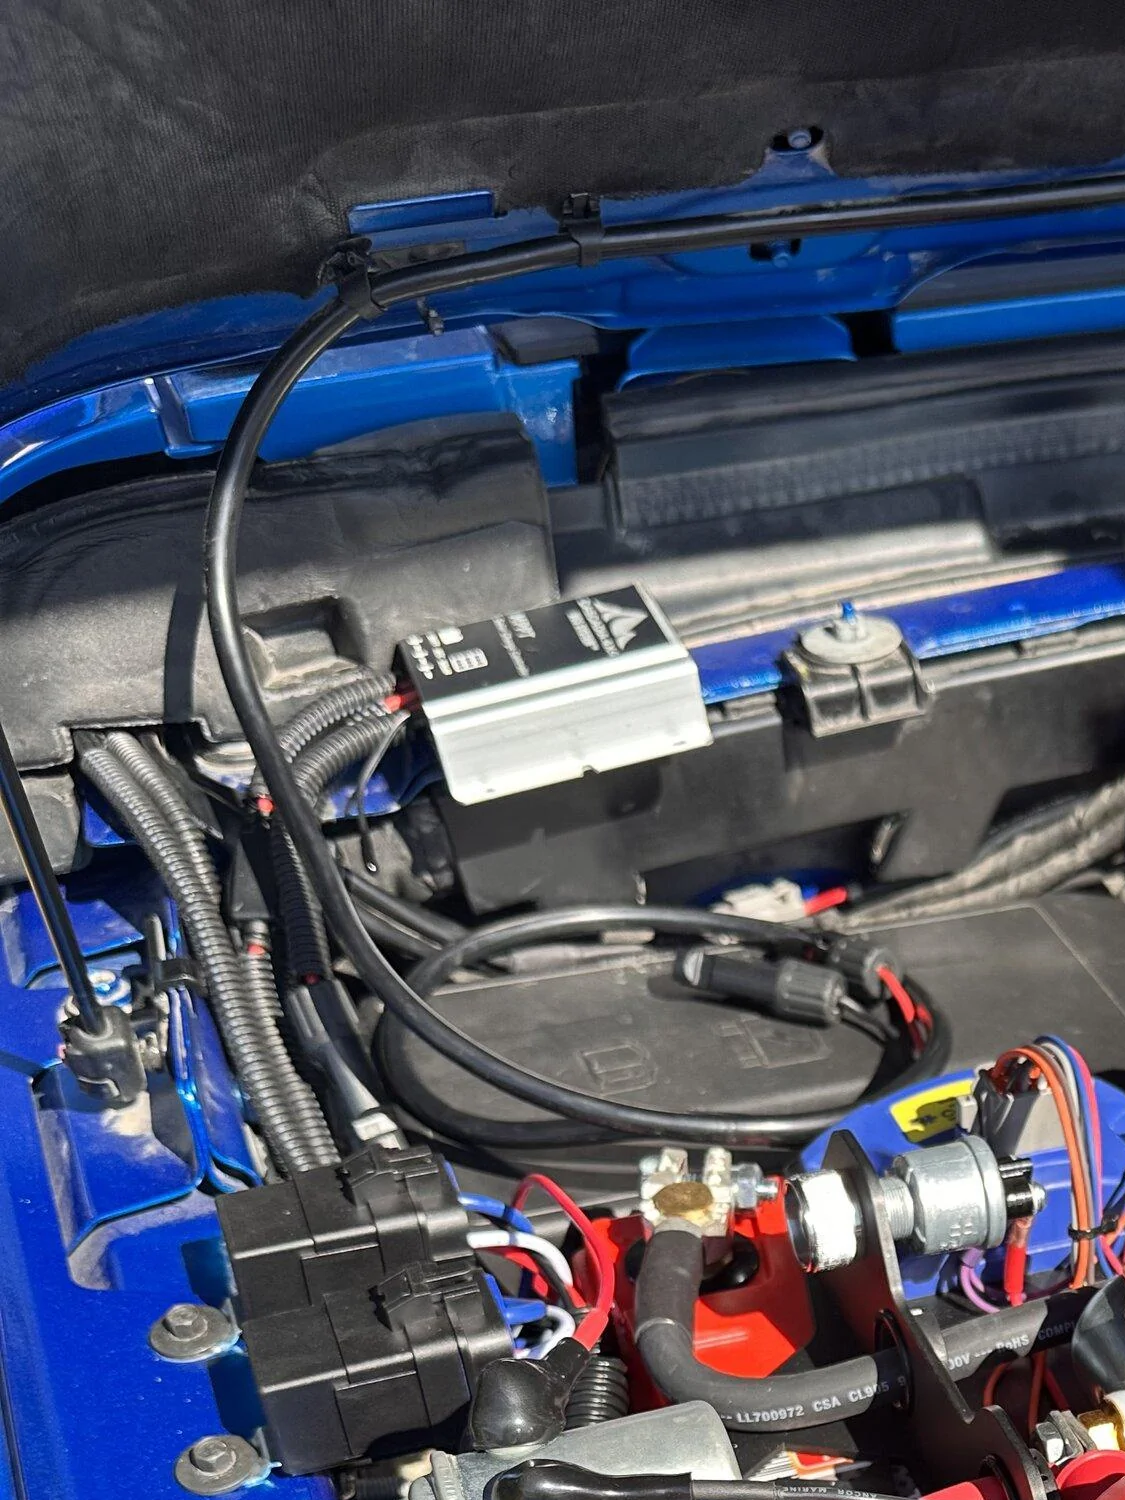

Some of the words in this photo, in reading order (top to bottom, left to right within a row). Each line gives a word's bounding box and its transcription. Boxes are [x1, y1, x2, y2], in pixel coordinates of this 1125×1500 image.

[736, 1406, 805, 1423] LL700972
[812, 1398, 842, 1413] CSA
[837, 1489, 878, 1499] ANCOR
